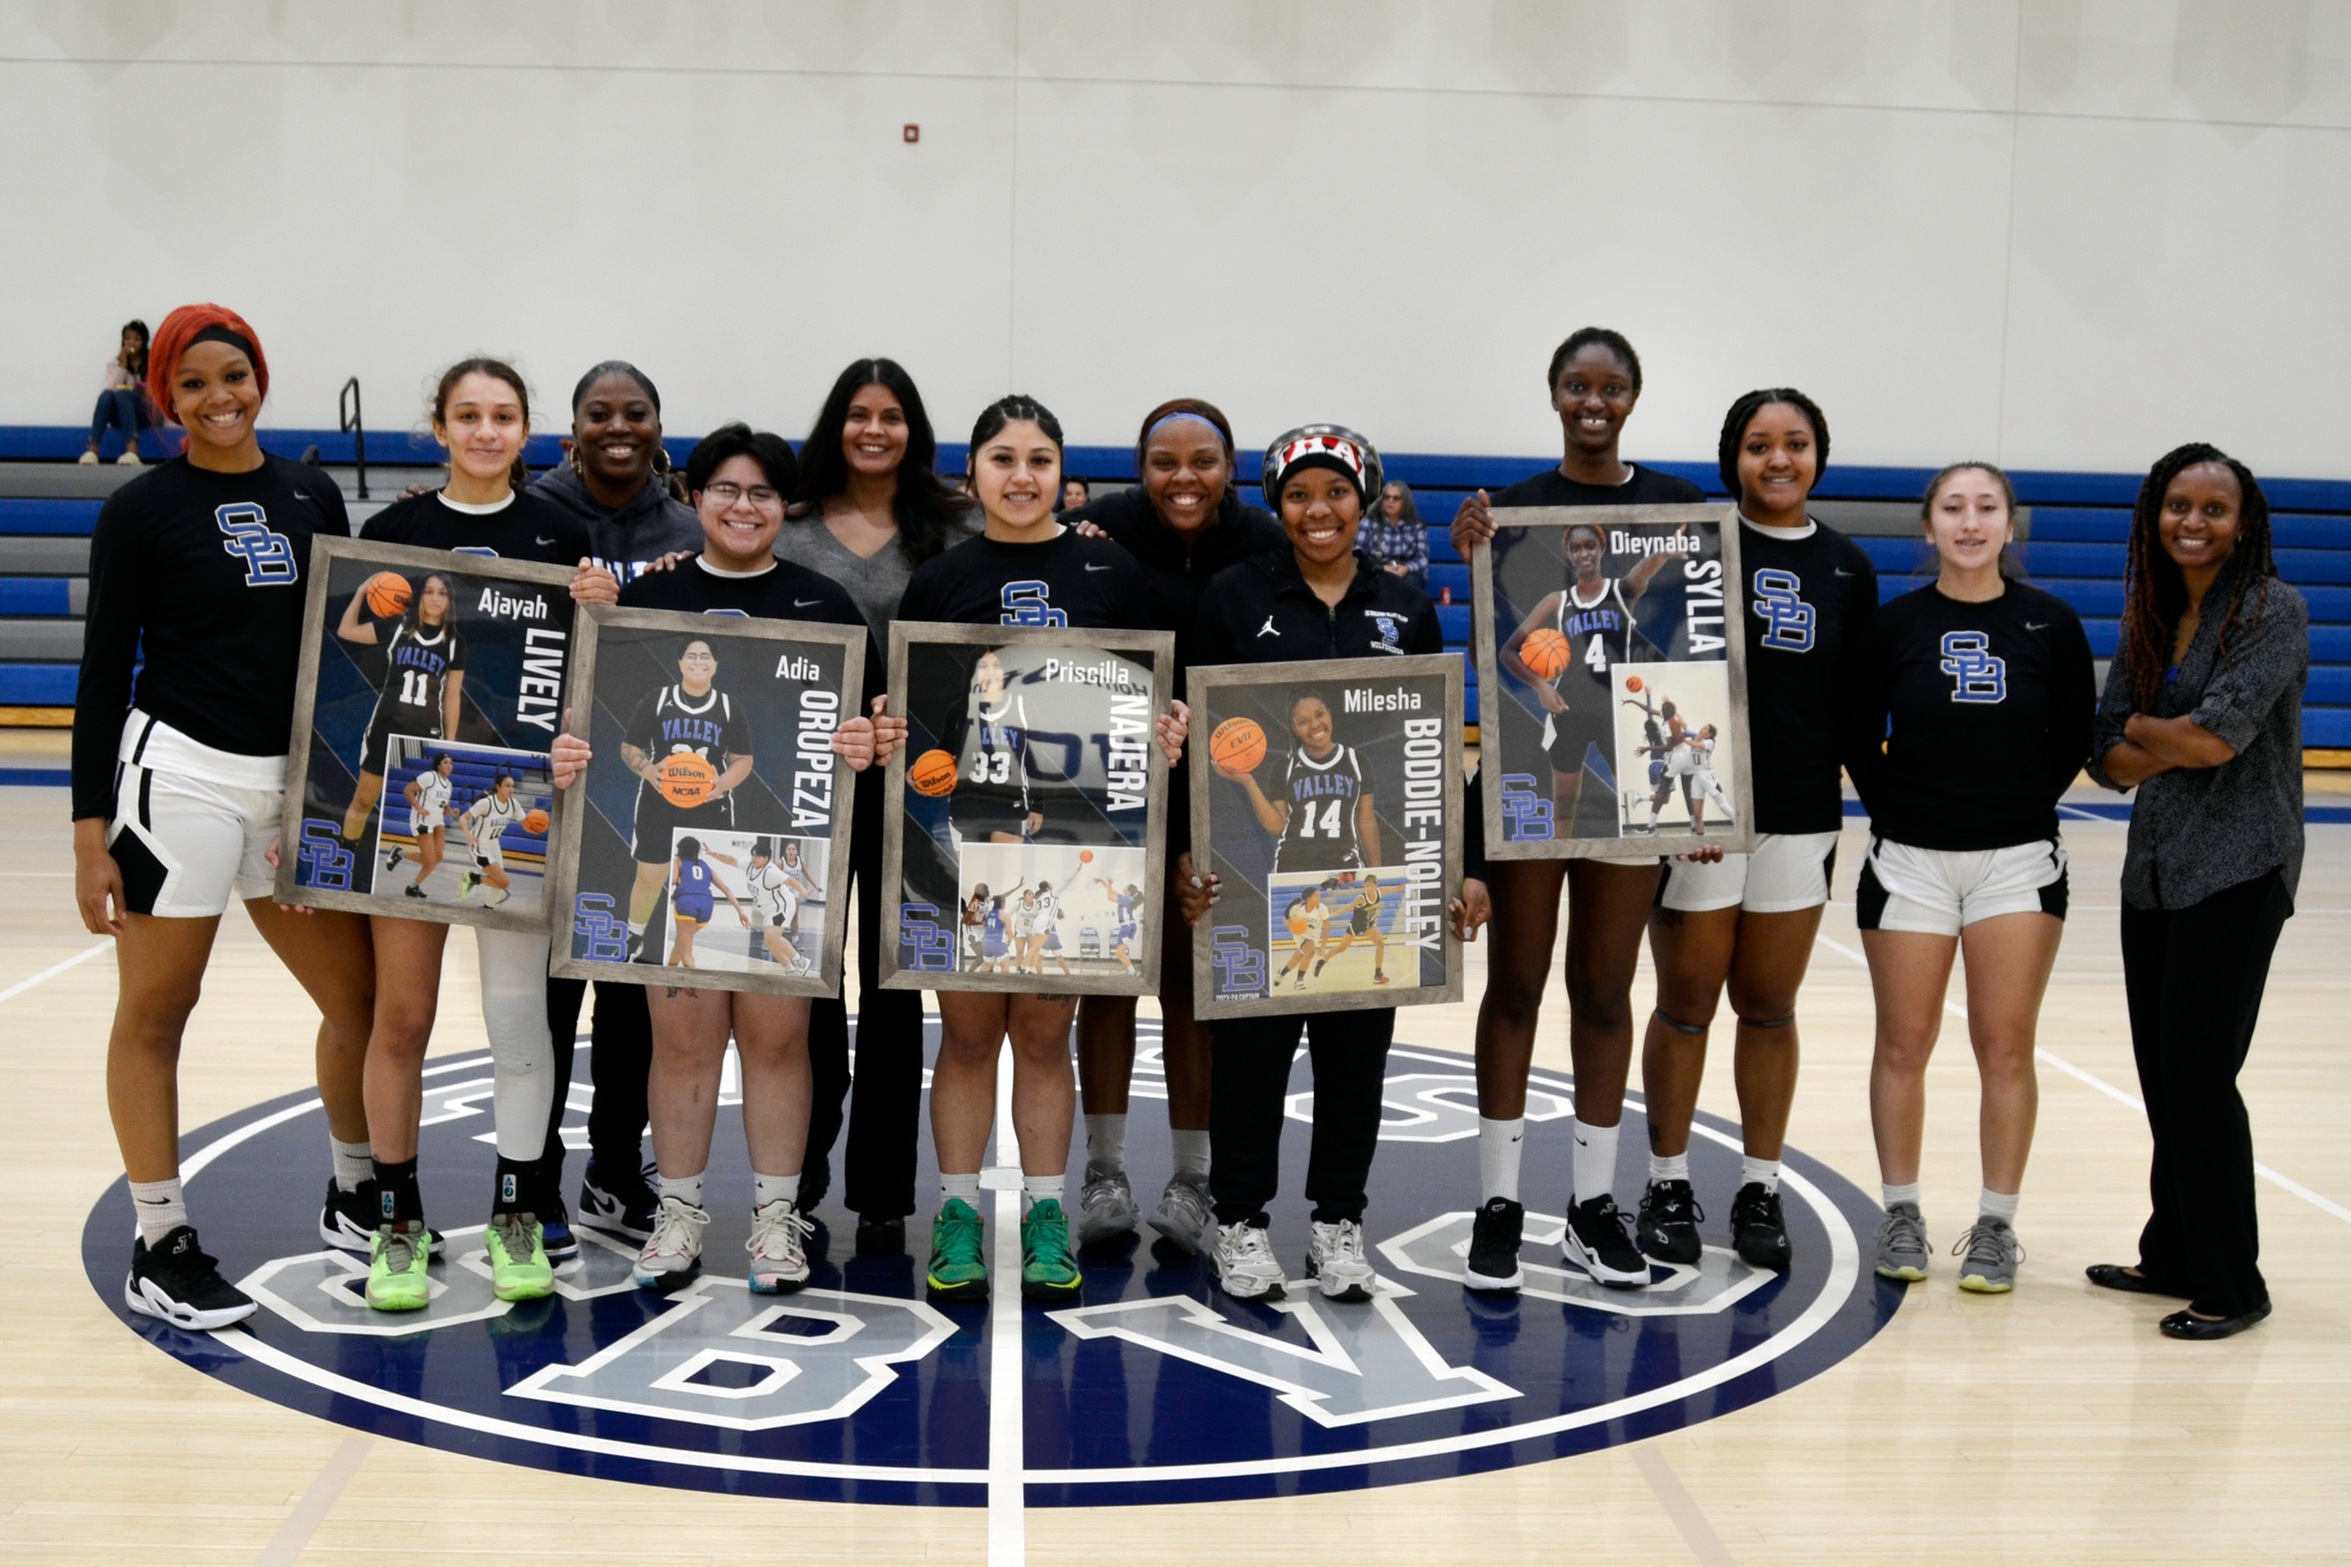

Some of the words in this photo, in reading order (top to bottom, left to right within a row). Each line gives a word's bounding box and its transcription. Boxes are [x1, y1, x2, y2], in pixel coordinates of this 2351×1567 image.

[214, 501, 298, 587] SB
[1610, 530, 1701, 558] Dieynaba
[478, 588, 547, 620] Ajayah
[1684, 559, 1727, 654] SYLLA
[1752, 567, 1816, 653] SB
[1565, 609, 1620, 638] VALLEY
[397, 647, 446, 676] VALLEY
[775, 655, 819, 681] Adia
[1585, 634, 1606, 672] 4
[1939, 629, 2007, 704] SB
[399, 670, 428, 706] 11
[517, 628, 566, 732] LIVELY
[1046, 658, 1129, 685] Priscilla
[1344, 687, 1421, 713] Milesha
[662, 718, 722, 747] VALLEY
[792, 689, 838, 828] OROPEZA
[968, 751, 1011, 784] 33
[1106, 694, 1149, 812] NAJERA
[668, 766, 705, 779] Wilson
[921, 772, 951, 788] Wilson
[1293, 775, 1354, 801] VALLEY
[672, 786, 700, 796] NCAA
[1501, 773, 1554, 841] SB
[1300, 801, 1342, 838] 14
[1403, 718, 1441, 951] BODDIE-NOLLEY
[300, 818, 354, 891] SB
[691, 865, 703, 880] 0
[576, 892, 628, 963] SB
[900, 902, 955, 972] SB
[1212, 925, 1265, 991] SB
